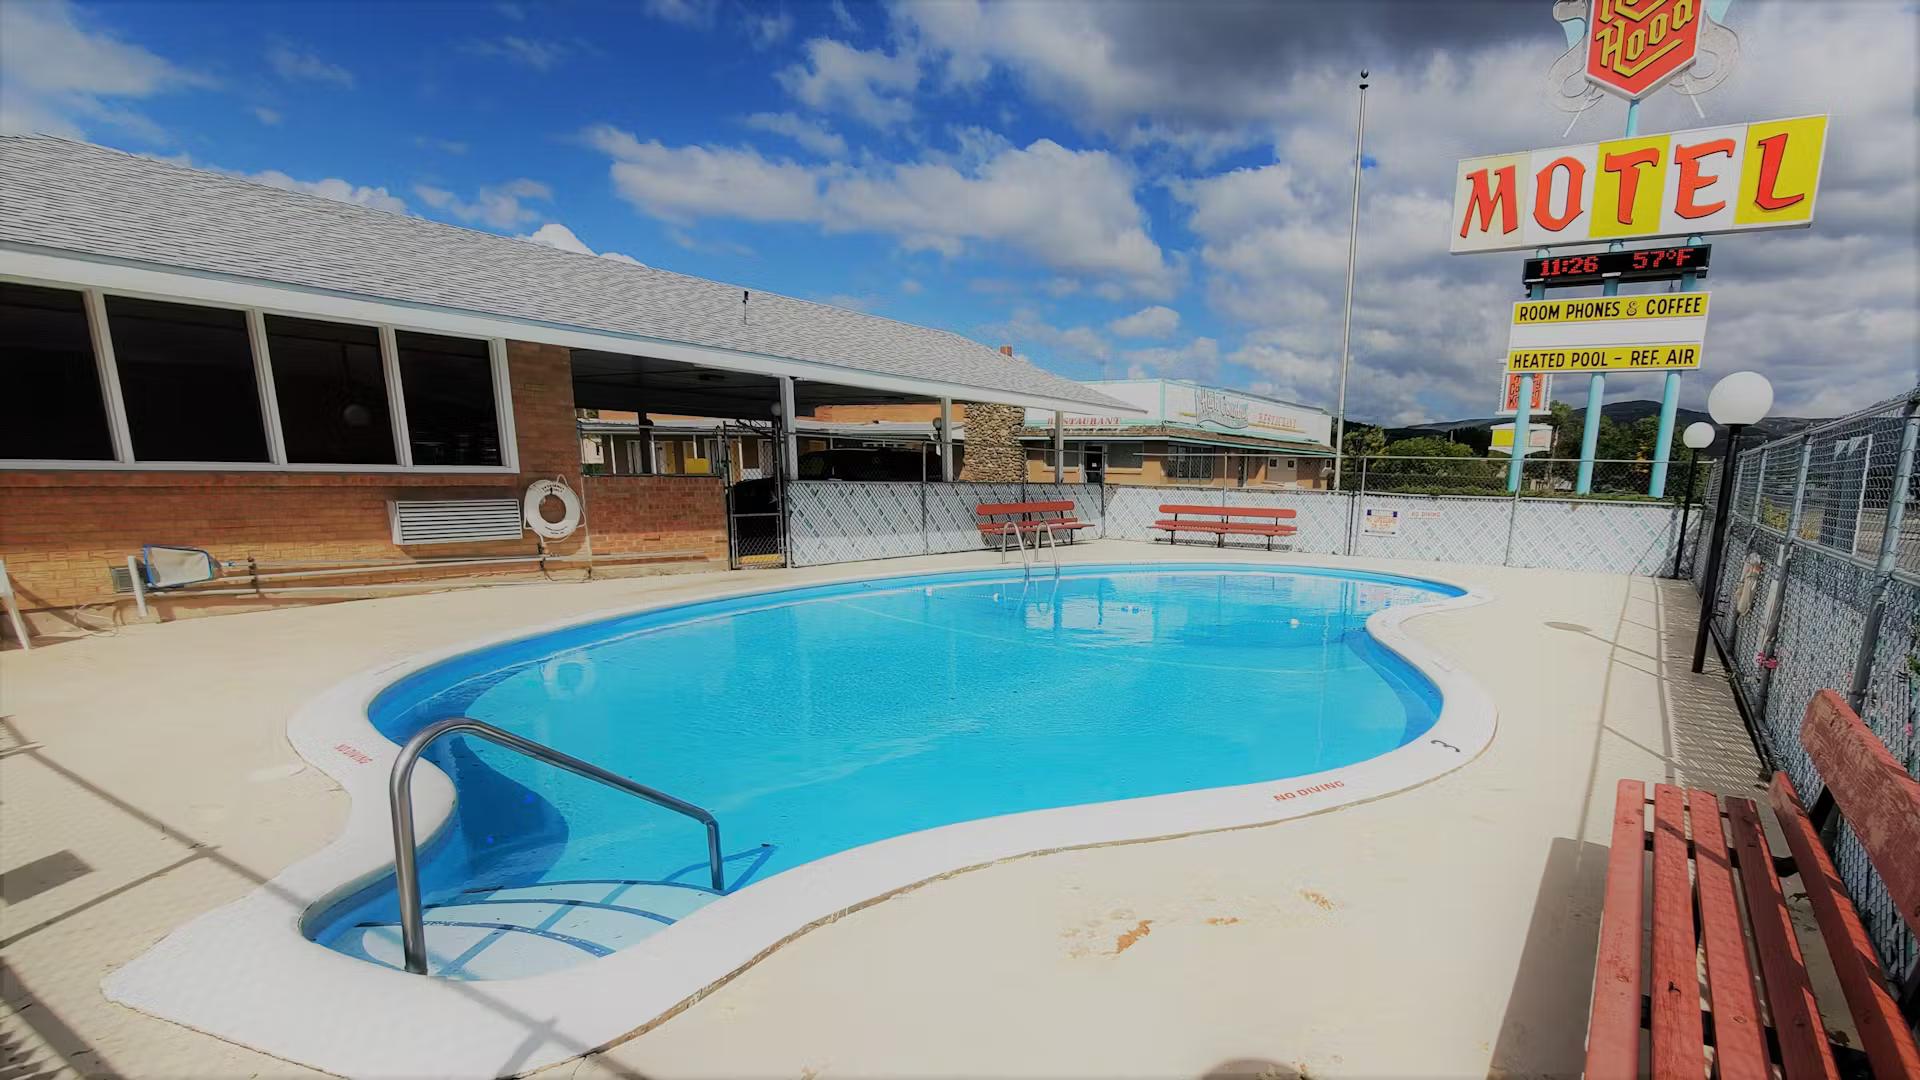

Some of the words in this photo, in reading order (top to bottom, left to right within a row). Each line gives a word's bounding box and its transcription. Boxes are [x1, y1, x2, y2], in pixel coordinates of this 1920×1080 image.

[1595, 0, 1695, 77] Hood
[1459, 132, 1805, 238] MOTEL
[1540, 255, 1600, 277] 11:26
[1519, 304, 1561, 321] ROOM
[1566, 301, 1620, 319] PHONES
[1626, 300, 1640, 316] &
[1646, 296, 1703, 315] COFFEE
[1513, 352, 1566, 369] HEATED
[1571, 351, 1608, 367] POOL
[1630, 350, 1661, 366] REF.
[1665, 348, 1695, 365] AIR
[1047, 416, 1121, 426] RSTAURANT
[1272, 791, 1296, 802] NO
[1299, 780, 1345, 797] DIVING
